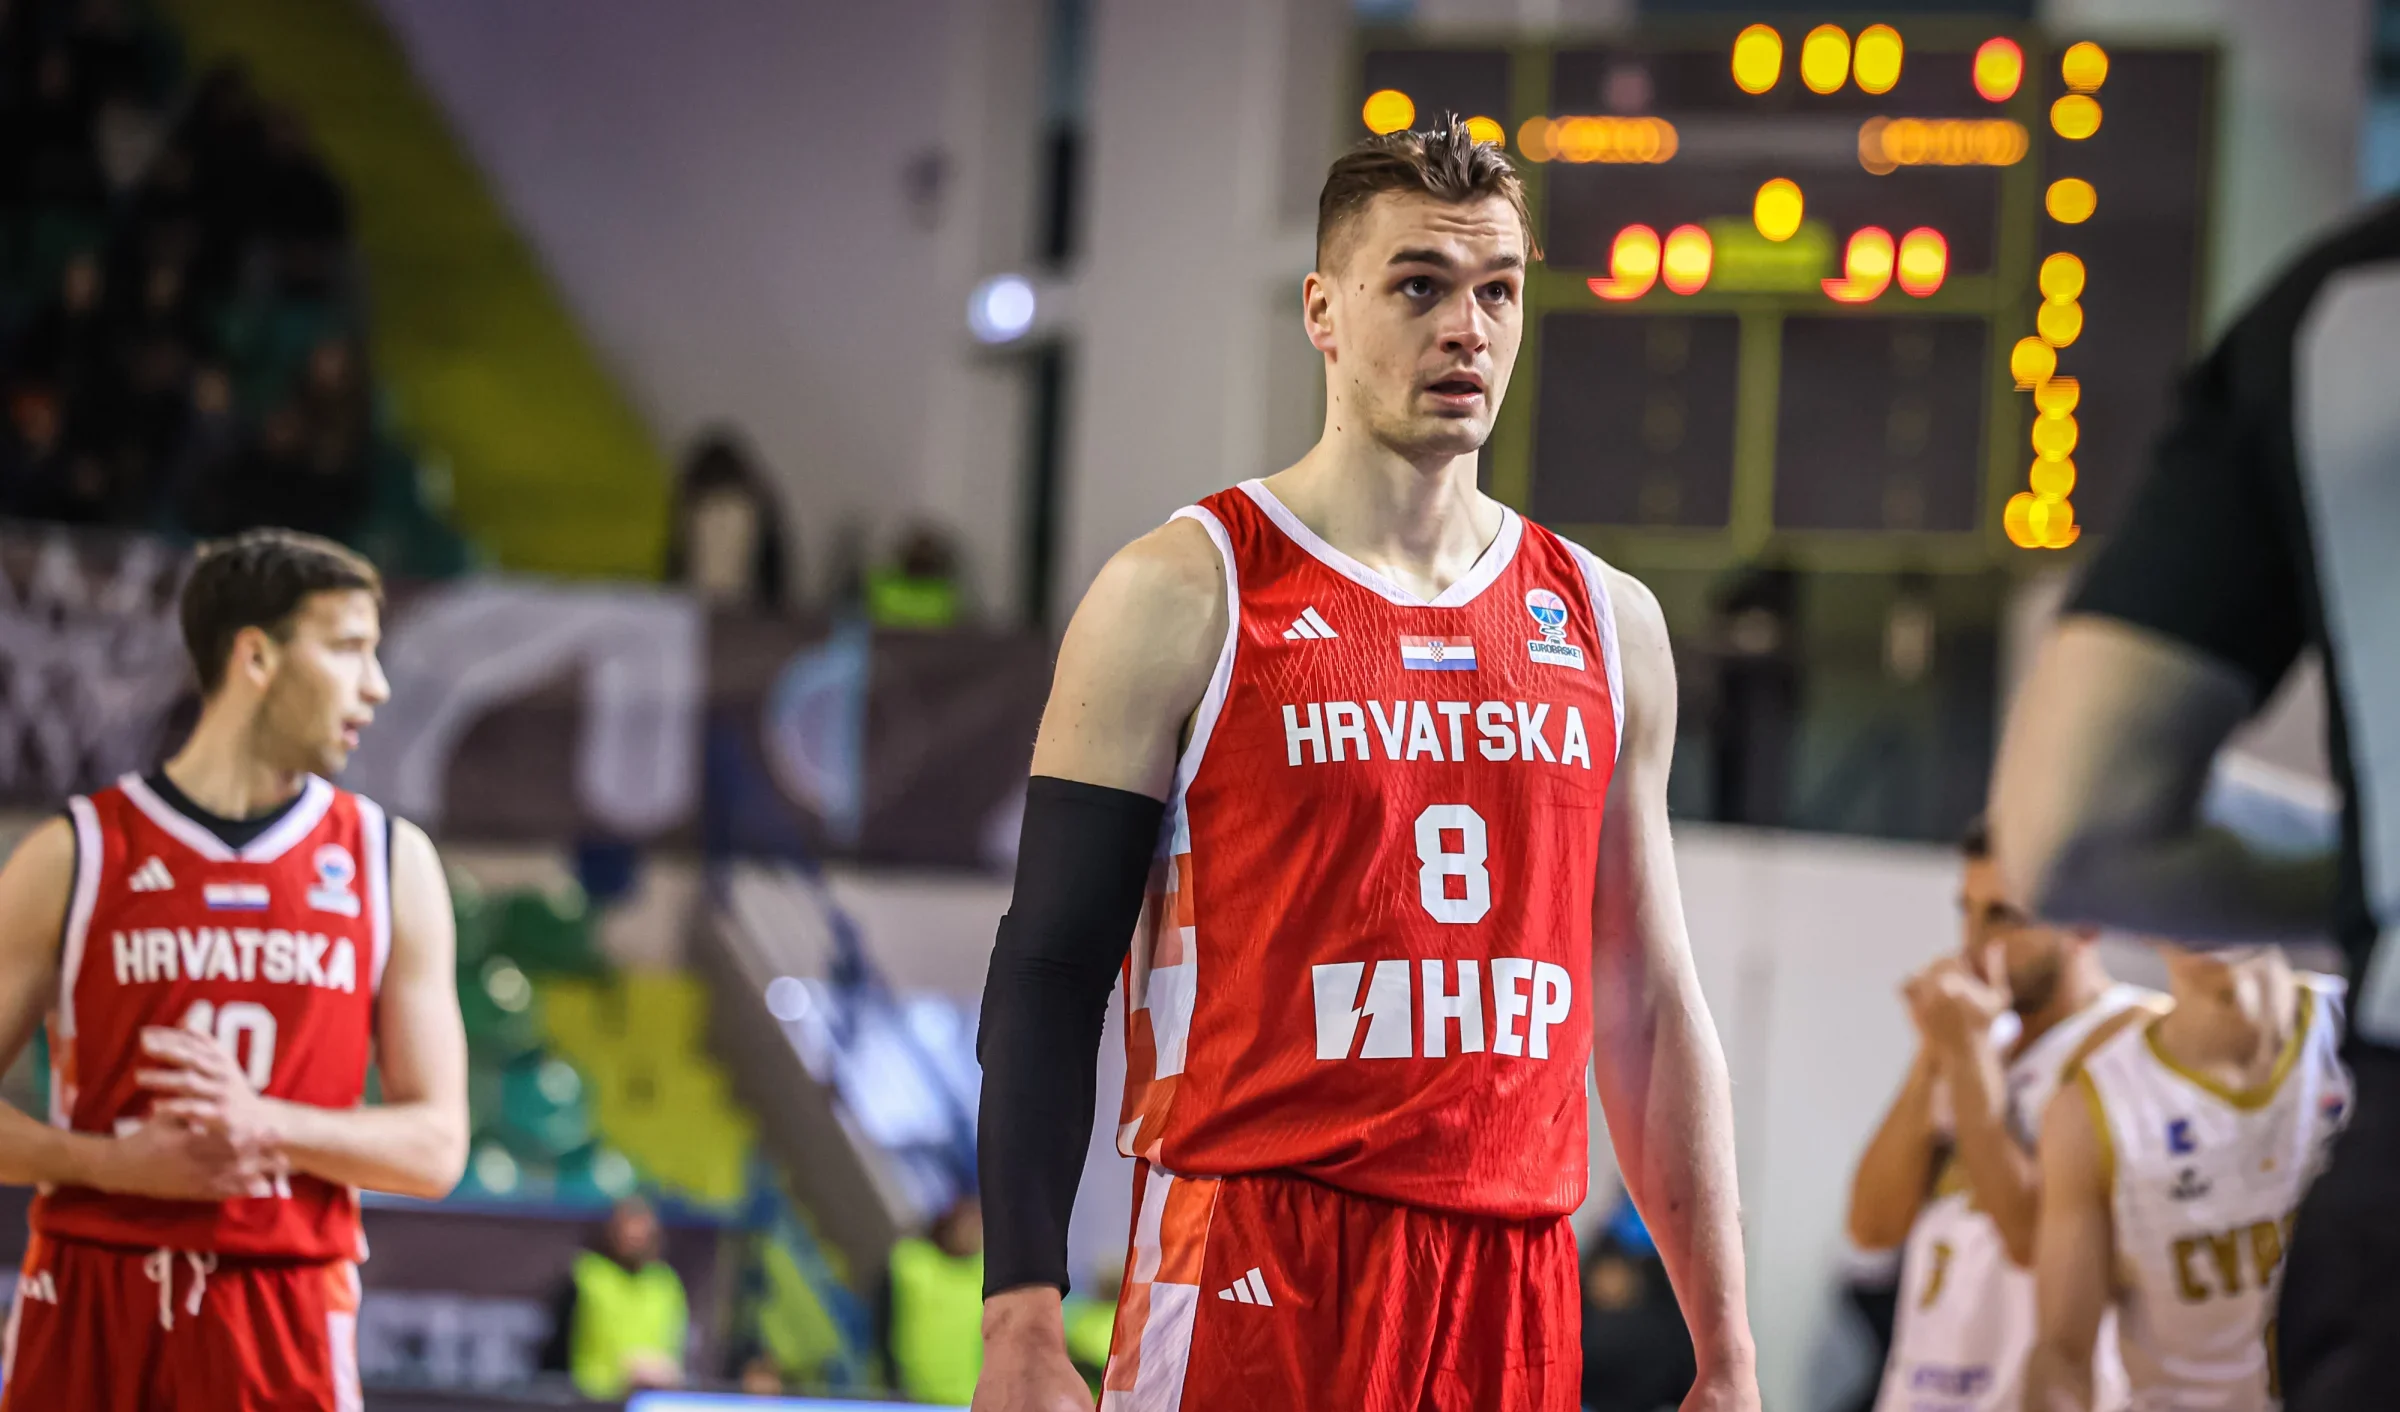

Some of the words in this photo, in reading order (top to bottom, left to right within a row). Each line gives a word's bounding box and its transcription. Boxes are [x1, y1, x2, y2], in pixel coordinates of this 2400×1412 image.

[1529, 642, 1581, 659] EUROBASKET
[1282, 700, 1591, 770] HRVATSKA
[1414, 804, 1491, 924] 8
[112, 926, 356, 994] HRVATSKA
[1421, 957, 1572, 1059] HEP
[2170, 1211, 2299, 1303] CYP
